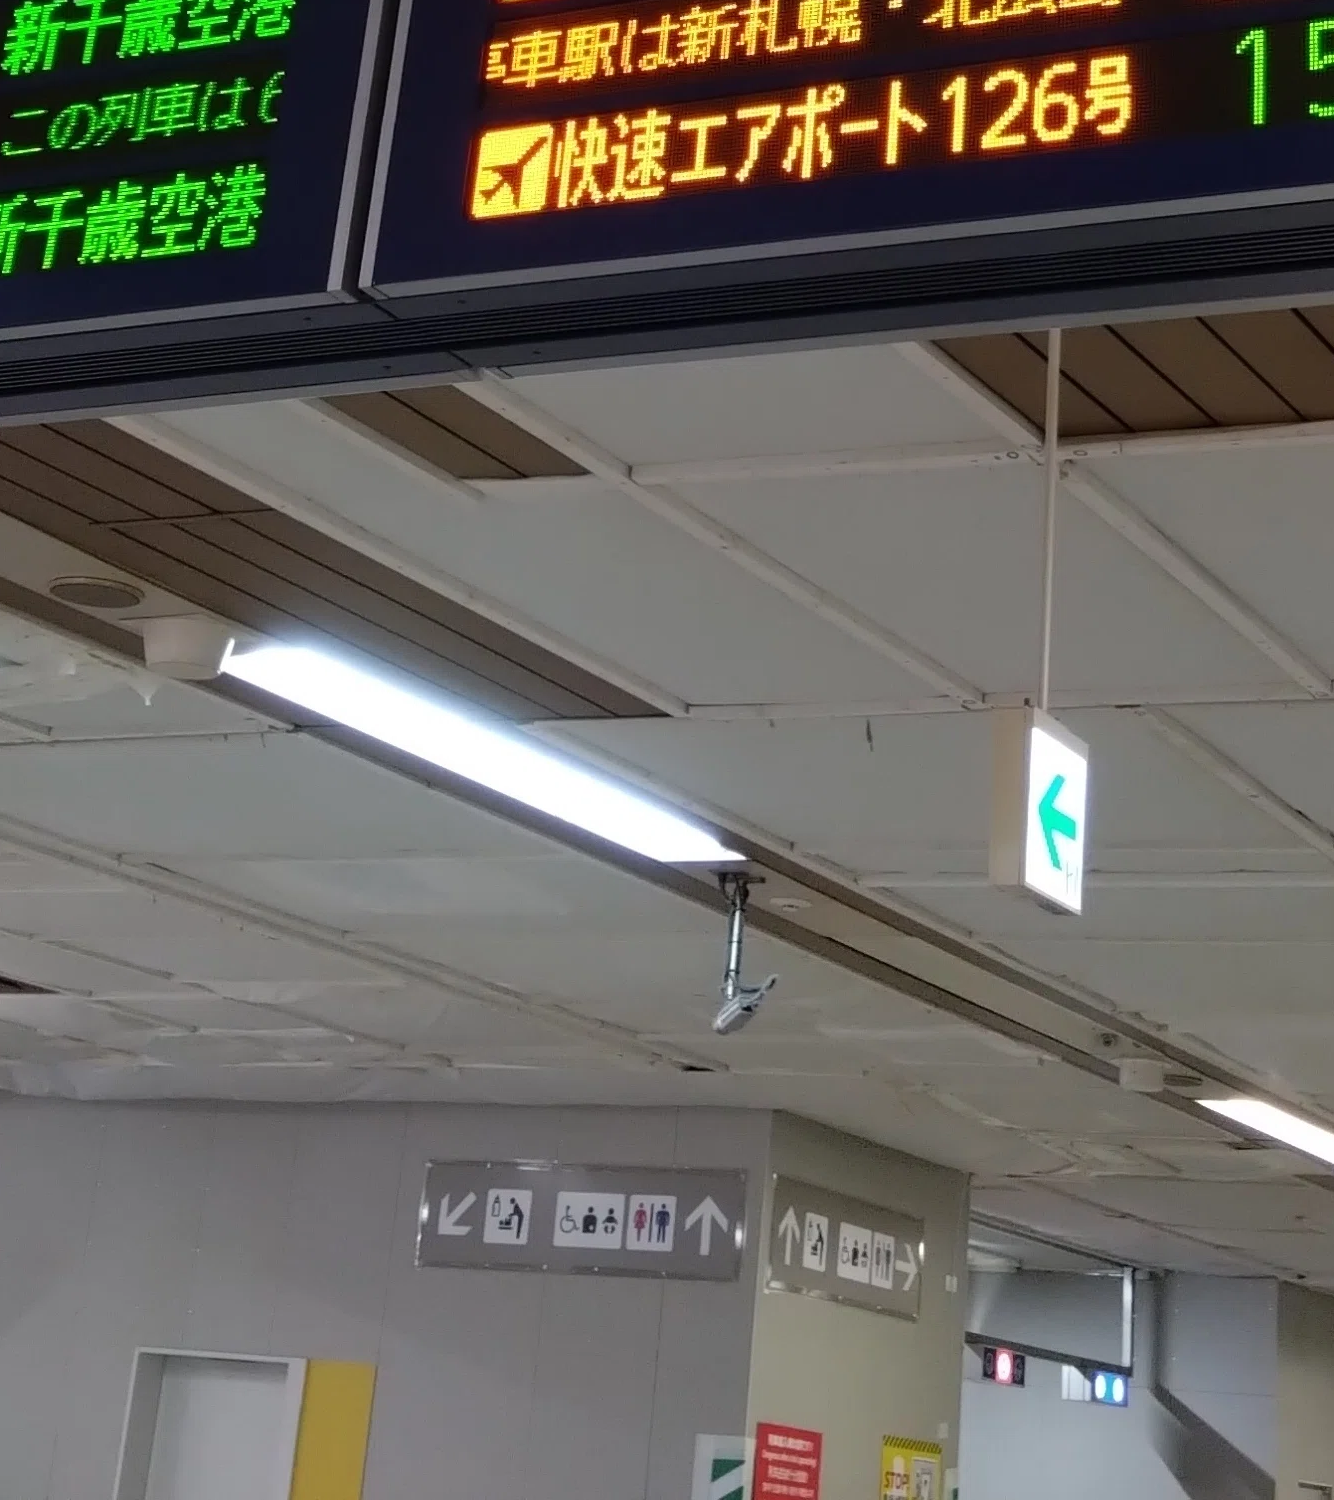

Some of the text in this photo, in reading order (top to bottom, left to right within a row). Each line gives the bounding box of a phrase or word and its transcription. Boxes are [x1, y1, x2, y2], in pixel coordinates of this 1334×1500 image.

[548, 53, 1133, 210] 快速エアポート126号
